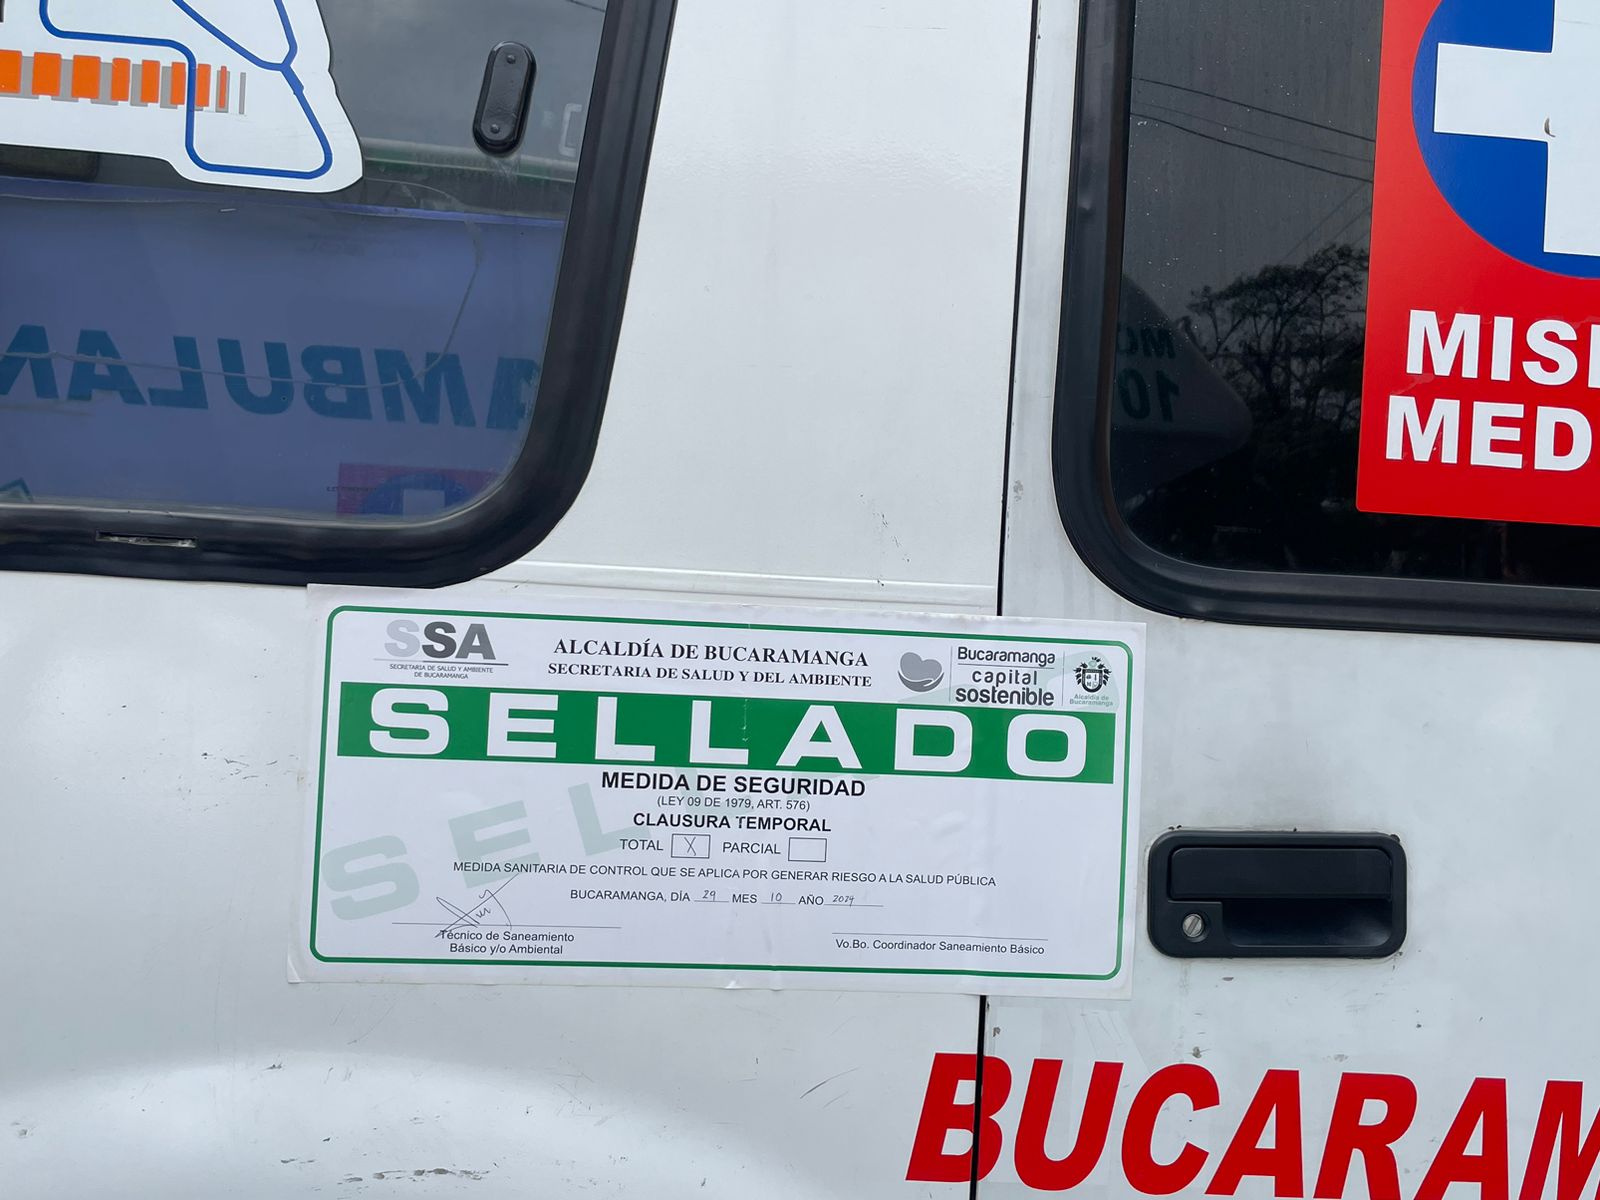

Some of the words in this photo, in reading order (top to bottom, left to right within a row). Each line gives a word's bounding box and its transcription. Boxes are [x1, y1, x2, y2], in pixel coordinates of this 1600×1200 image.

[1385, 394, 1593, 472] MED
[384, 619, 496, 660] SSA
[553, 638, 664, 658] ALCALDÍA
[670, 643, 699, 660] DE
[704, 645, 869, 667] BUCARAMANGA
[957, 646, 1056, 668] Bucaramanga
[424, 672, 469, 680] BUCARAMANGA
[548, 662, 652, 679] SECRETARIA
[656, 667, 678, 679] DE
[681, 668, 735, 682] SALUD
[738, 671, 750, 683] Y
[753, 672, 784, 685] DEL
[788, 673, 873, 688] AMBIENTE
[972, 670, 1038, 688] capital
[955, 687, 1055, 707] sostenible
[369, 687, 1088, 778] SELLADO
[601, 771, 690, 791] MEDIDA
[696, 775, 727, 793] DE
[733, 776, 866, 797] SEGURIDAD
[657, 796, 684, 807] (LEY
[687, 797, 701, 808] 09
[704, 798, 721, 808] DE
[725, 798, 754, 810] 1979,
[757, 800, 784, 811] ART.
[786, 801, 811, 812] 576)
[633, 812, 731, 829] CLAUSURA
[736, 816, 832, 832] TEMPORAL
[620, 838, 664, 852] TOTAL
[722, 841, 781, 855] PARCIAL
[453, 861, 501, 873] MEDIDA
[503, 862, 567, 875] SANITARIA
[569, 864, 587, 875] DE
[589, 864, 648, 877] CONTROL
[650, 866, 677, 878] QUE
[679, 867, 696, 878] SE
[698, 868, 740, 879] APLICA
[742, 869, 768, 880] POR
[771, 870, 829, 882] GENERAR
[832, 871, 877, 884] RIESGO
[878, 873, 888, 883] A
[889, 873, 904, 884] LA
[905, 873, 944, 885] SALUD
[947, 873, 997, 888] PÚBLICA
[570, 889, 668, 903] BUCARAMANGA,
[670, 890, 691, 902] DÍA
[732, 894, 758, 905] MES
[798, 895, 825, 906] AÑO
[440, 930, 484, 940] Técnico
[485, 931, 500, 940] de
[502, 931, 575, 942] Saneamiento
[449, 943, 487, 954] Básico
[489, 944, 506, 956] y/o
[508, 945, 564, 955] Ambiental
[835, 938, 870, 949] Vo.Bo.
[872, 939, 936, 951] Coordinador
[938, 941, 1007, 954] Saneamiento
[1010, 943, 1045, 955] Básico
